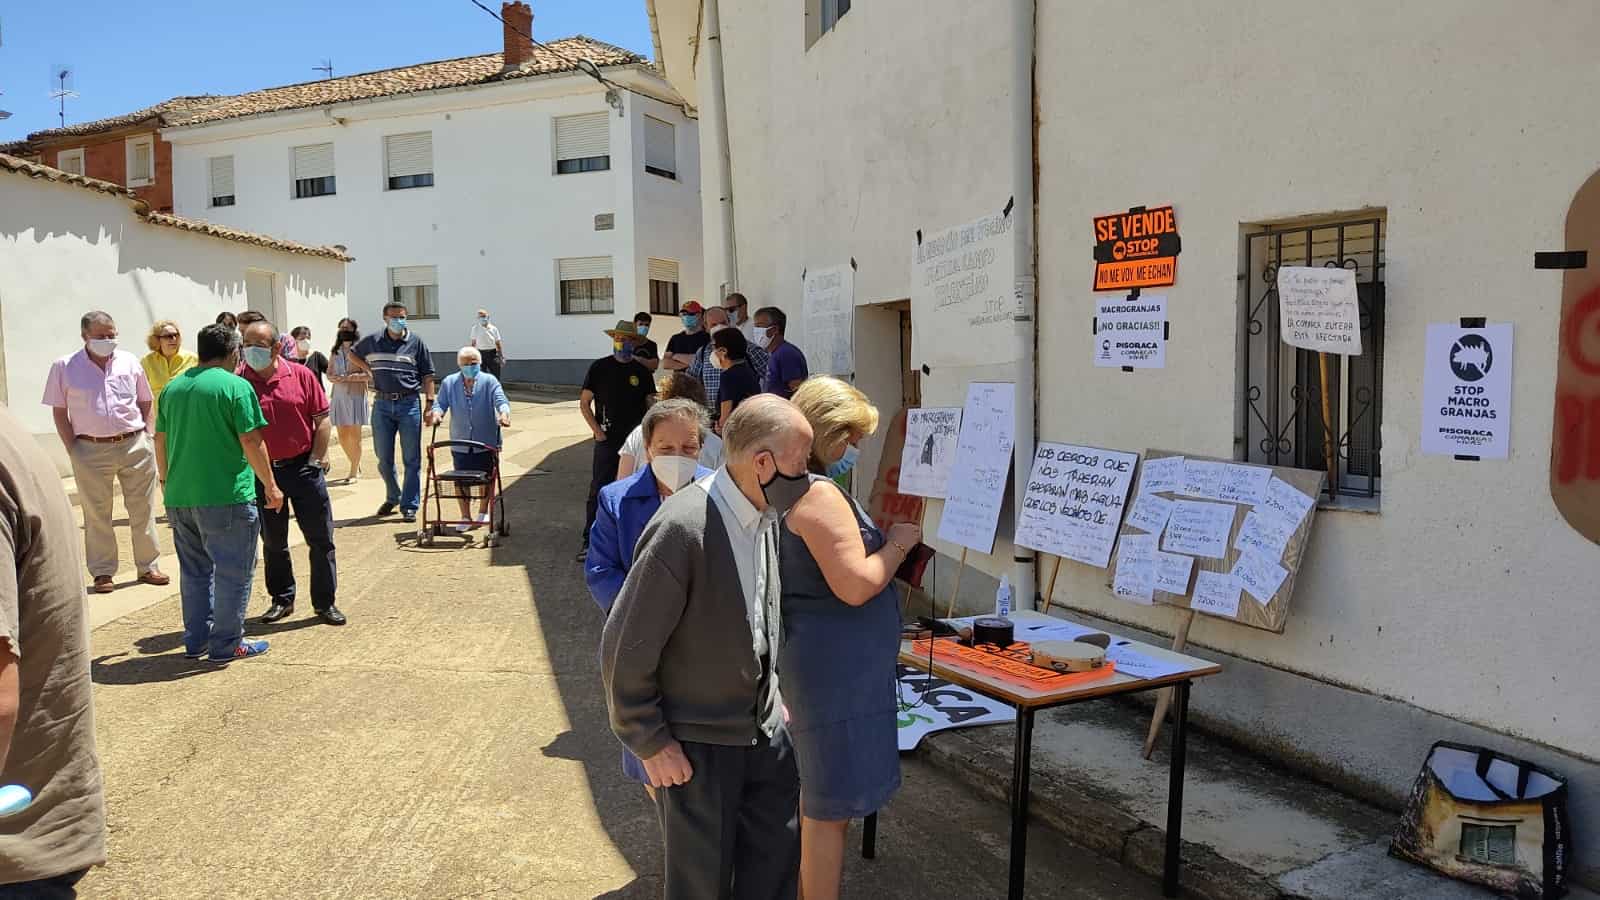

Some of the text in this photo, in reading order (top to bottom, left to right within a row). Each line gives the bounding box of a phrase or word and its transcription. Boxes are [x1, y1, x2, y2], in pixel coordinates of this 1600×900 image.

[1097, 209, 1175, 241] SE VENDE
[1126, 238, 1159, 252] STOP
[1099, 269, 1110, 284] NO
[1110, 268, 1119, 282] ME
[1136, 265, 1146, 281] ME
[1146, 263, 1172, 281] ECHAN
[1100, 304, 1161, 314] MACROGRANJAS
[1115, 341, 1158, 349] PISORACA
[1454, 386, 1485, 396] STOP
[1447, 396, 1490, 408] MACRO
[1440, 407, 1497, 419] GRANJAS
[1439, 427, 1493, 437] PISORACA
[1037, 447, 1055, 460] LOS
[1056, 451, 1099, 467] CERDOS
[1103, 459, 1130, 473] QUE
[1038, 462, 1117, 488] NOS TRAERAN
[1070, 487, 1089, 504] MAS
[1090, 492, 1122, 509] AGUA
[1023, 497, 1041, 509] QUE
[1040, 501, 1057, 515] LOS
